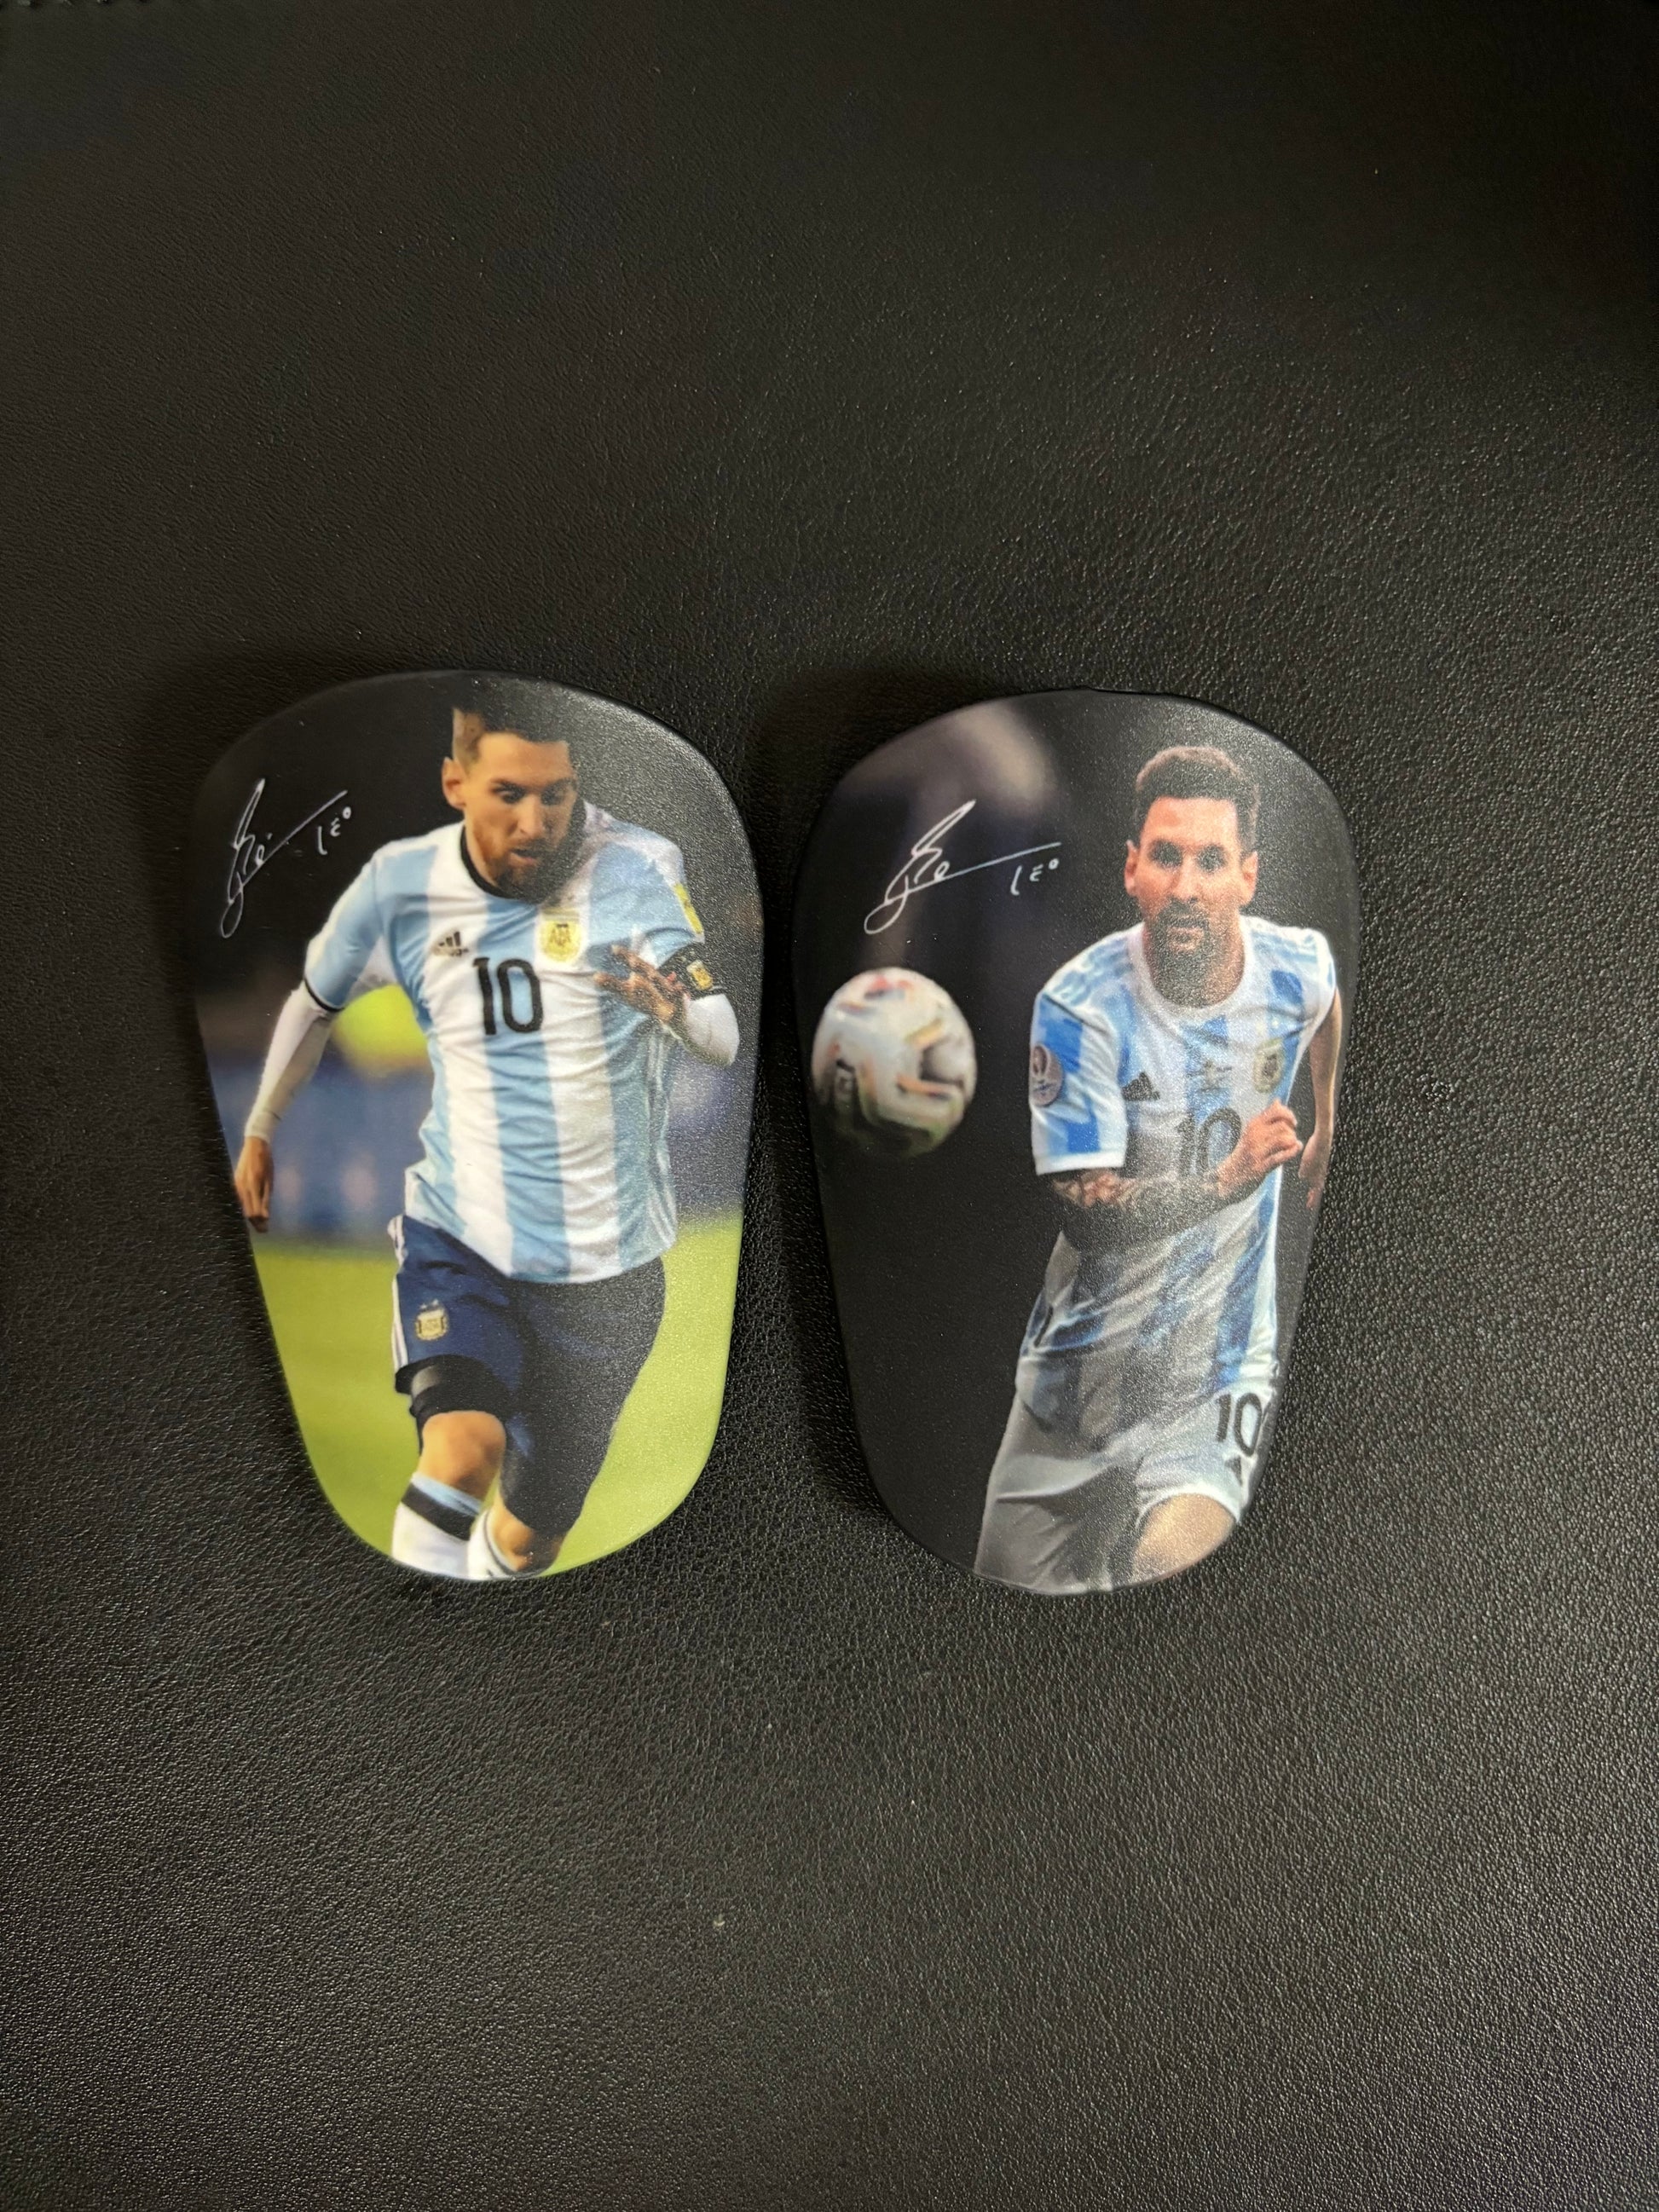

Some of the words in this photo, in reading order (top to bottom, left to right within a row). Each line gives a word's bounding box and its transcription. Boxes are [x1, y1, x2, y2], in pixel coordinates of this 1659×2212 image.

[472, 956, 544, 1035] 10
[1175, 1107, 1242, 1176] 10
[1215, 1392, 1263, 1457] 10
